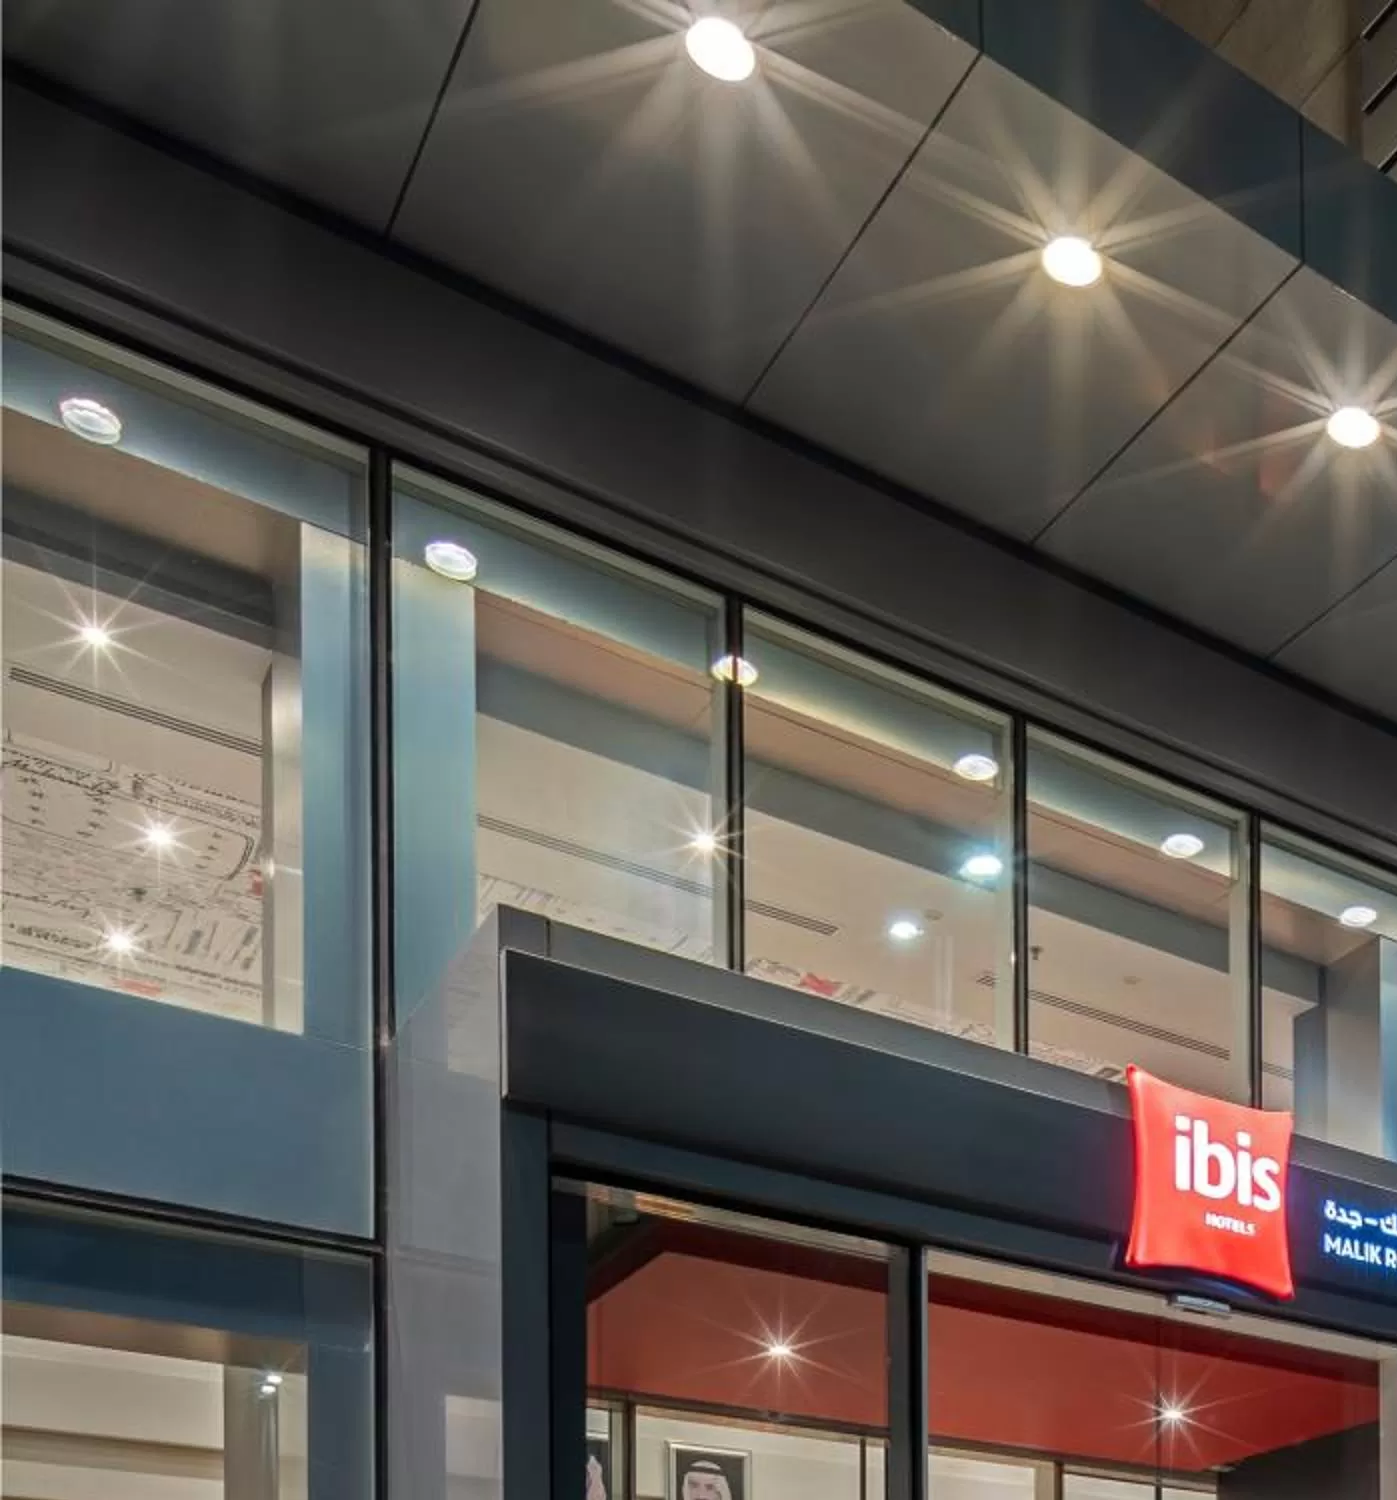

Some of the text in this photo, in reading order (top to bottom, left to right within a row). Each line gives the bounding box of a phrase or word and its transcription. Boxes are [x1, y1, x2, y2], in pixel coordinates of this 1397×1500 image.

[1173, 1113, 1282, 1213] ibis
[1205, 1212, 1256, 1237] HOTELS
[1323, 1199, 1363, 1230] جدة
[1323, 1233, 1382, 1266] MALIK
